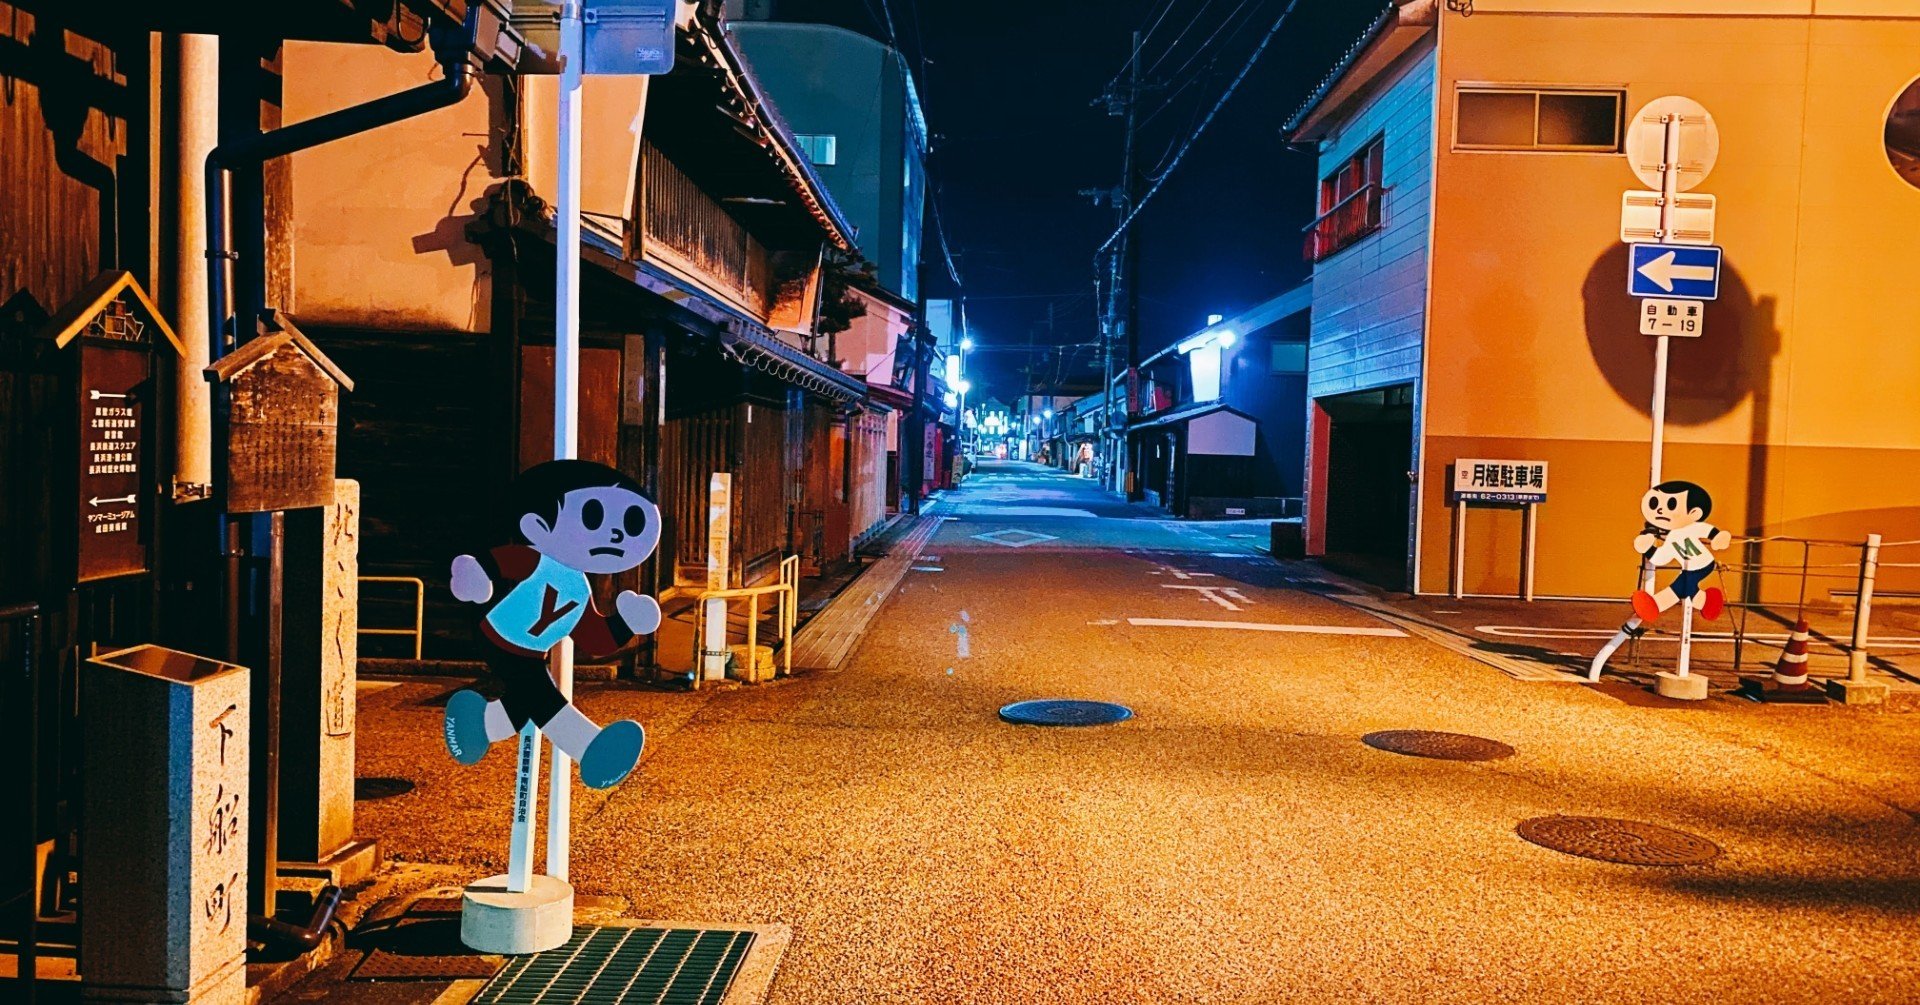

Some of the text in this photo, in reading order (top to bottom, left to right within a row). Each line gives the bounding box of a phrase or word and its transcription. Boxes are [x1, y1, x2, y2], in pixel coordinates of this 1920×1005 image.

[1647, 304, 1698, 317] 自動車
[1471, 463, 1544, 489] 月極駐車場
[1480, 493, 1515, 501] 62-0313
[1671, 537, 1703, 561] M
[526, 581, 581, 638] Y
[446, 716, 463, 757] YANMAR
[203, 703, 239, 937] 下船町
